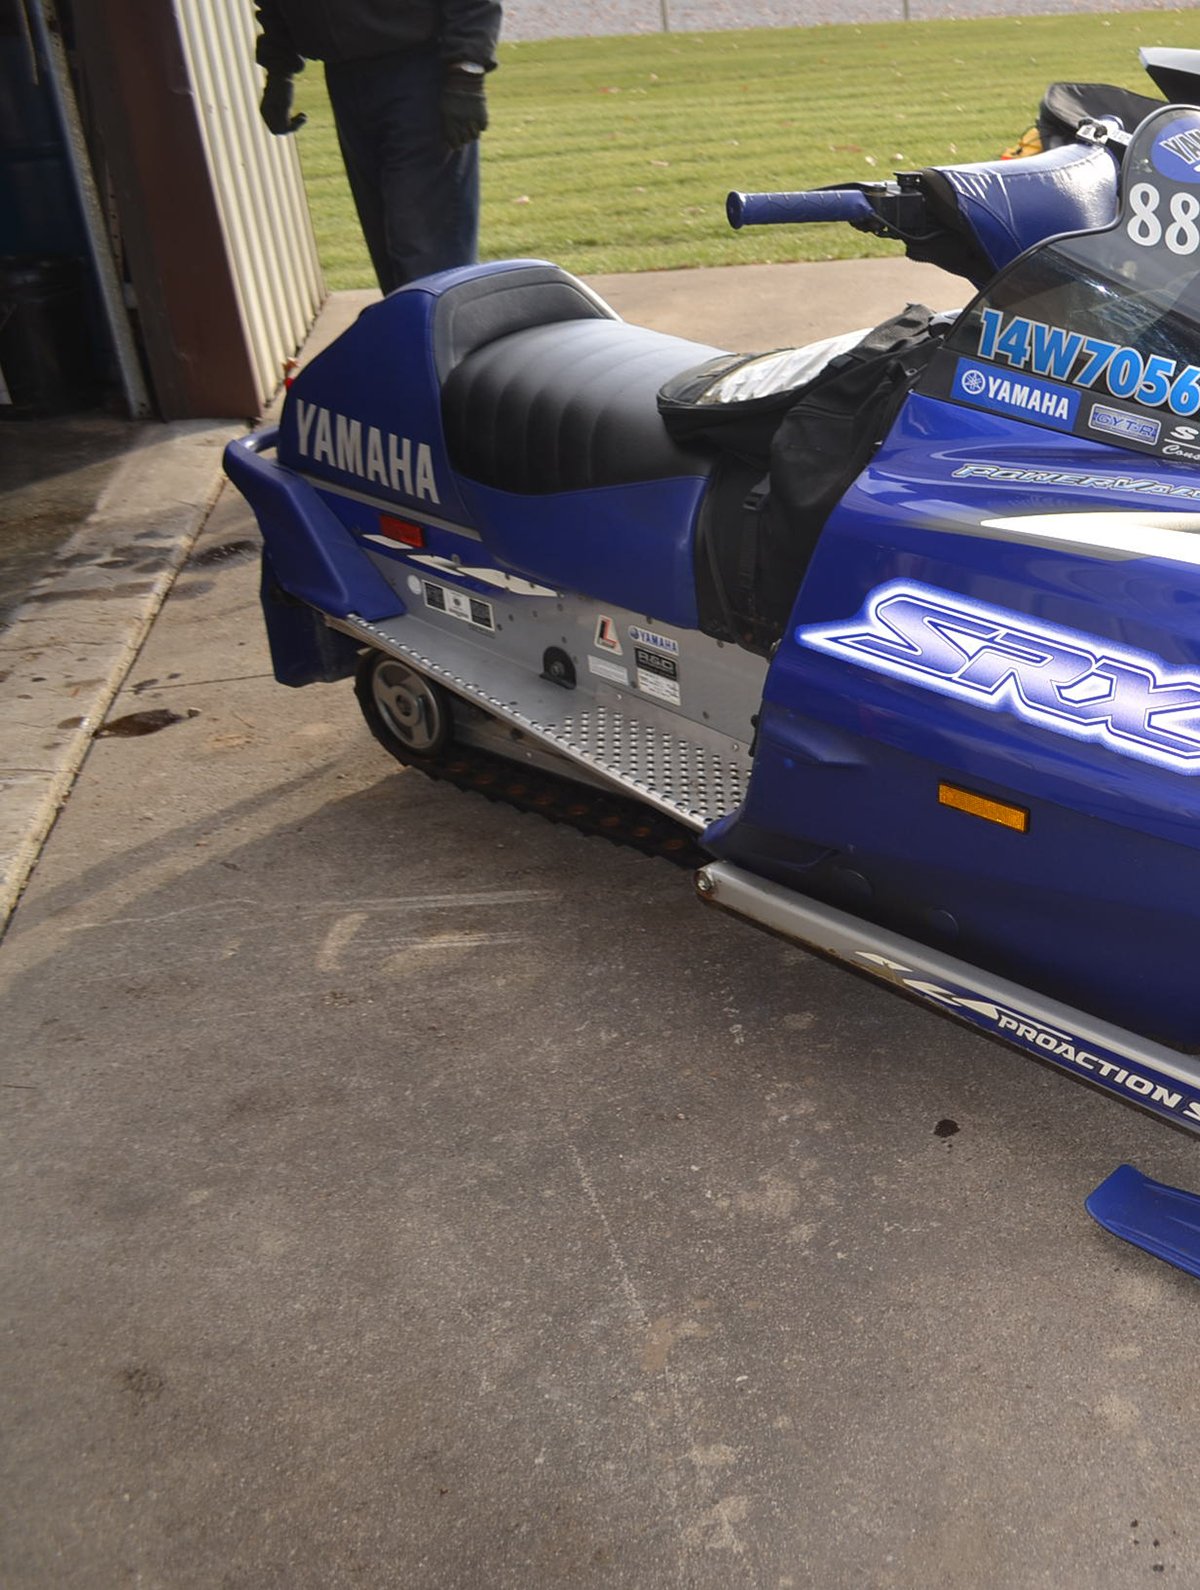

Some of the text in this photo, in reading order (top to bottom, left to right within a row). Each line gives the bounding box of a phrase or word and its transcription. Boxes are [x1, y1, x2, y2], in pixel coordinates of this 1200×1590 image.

[1127, 182, 1200, 255] 88
[988, 376, 1069, 420] YAMAHA
[296, 398, 440, 505] YAMAHA
[1170, 425, 1199, 440] S
[640, 631, 677, 651] YAMAHA
[998, 1015, 1185, 1107] PROACTION
